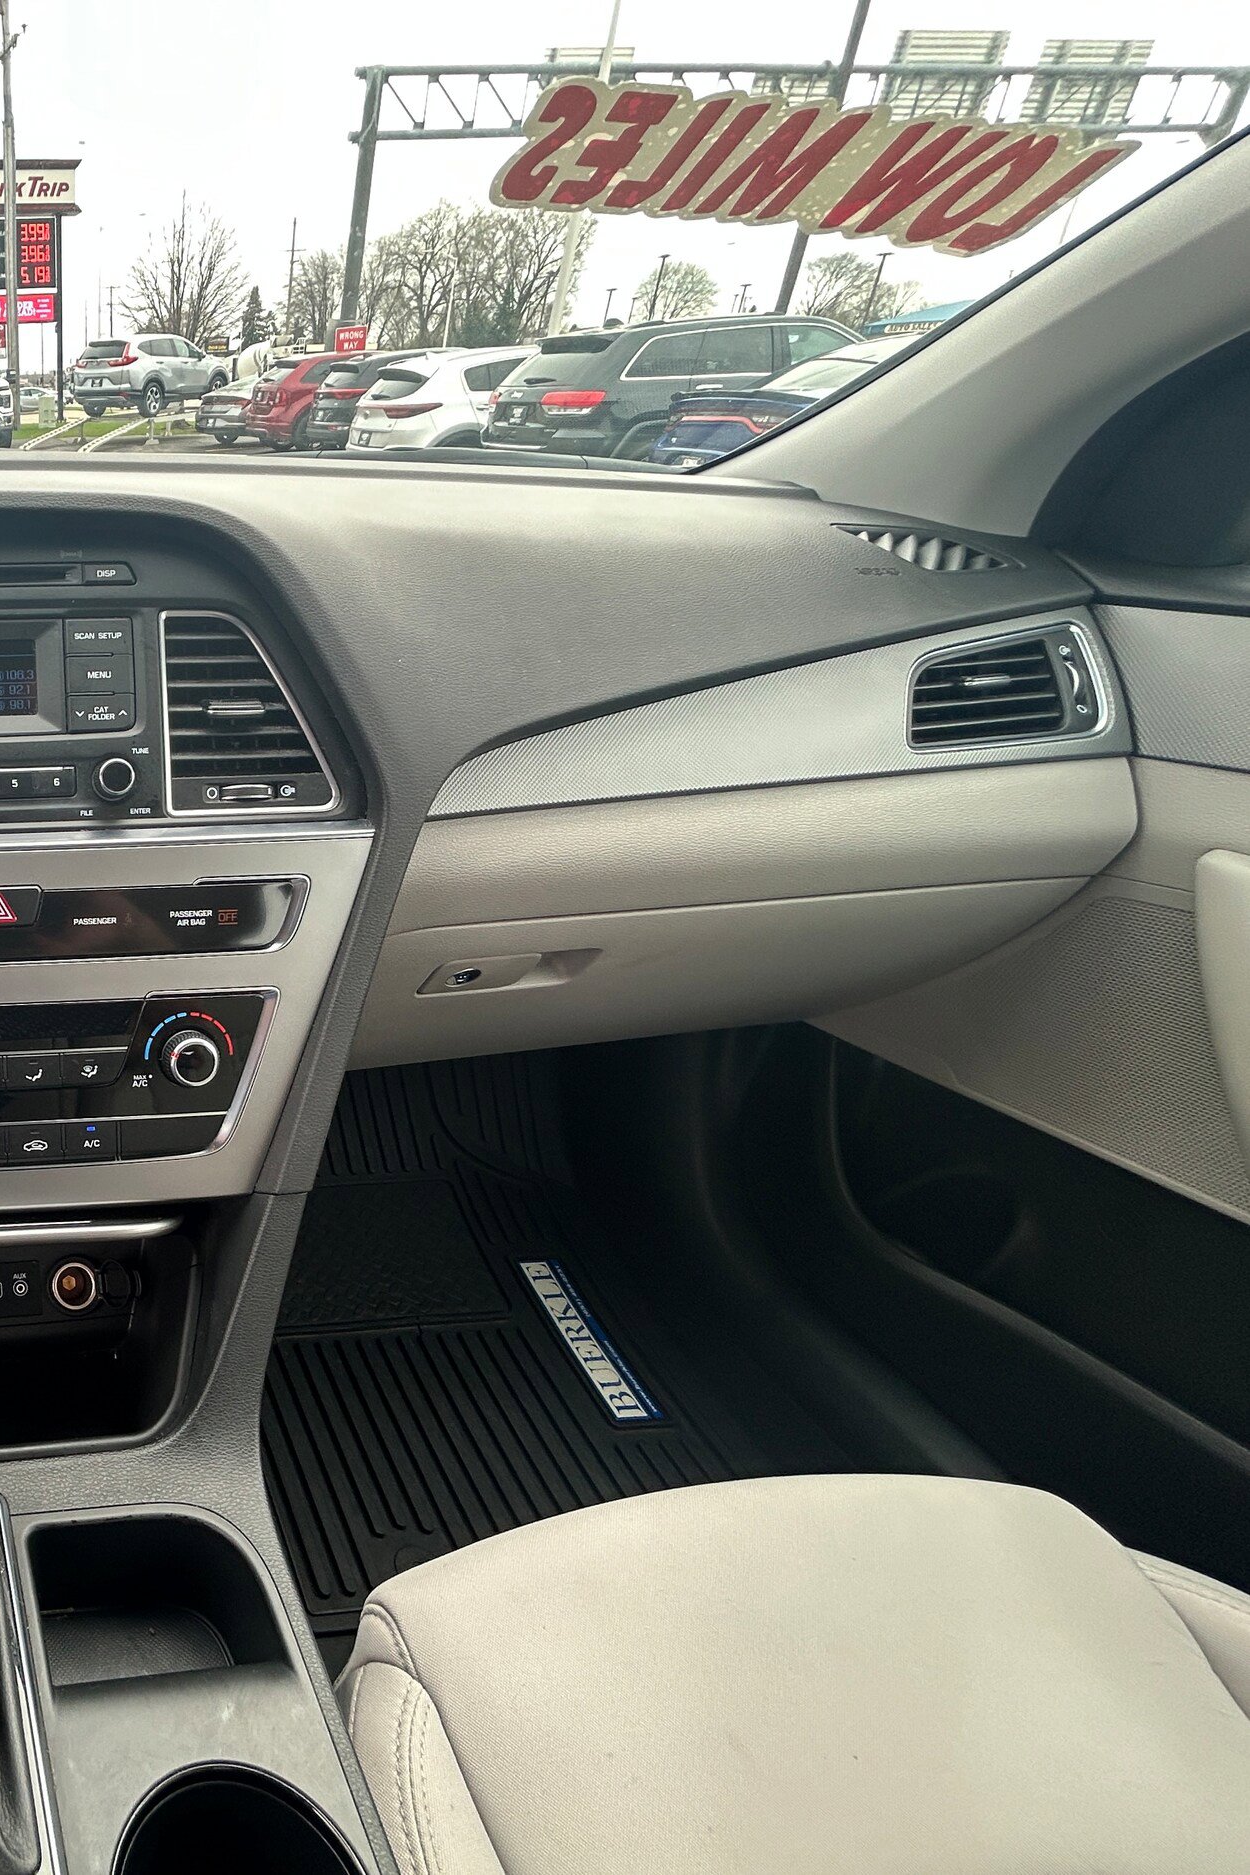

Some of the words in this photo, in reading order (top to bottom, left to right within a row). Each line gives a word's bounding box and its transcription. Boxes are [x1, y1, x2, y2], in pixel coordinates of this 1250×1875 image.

[340, 331, 364, 339] WRONG
[344, 342, 358, 350] WAY
[95, 570, 116, 578] DISP
[98, 632, 122, 640] SETUP
[87, 671, 111, 679] MENU
[88, 713, 115, 721] FOLDER
[11, 780, 18, 788] 5
[53, 778, 60, 786] 6
[169, 909, 212, 918] PASSENGER
[218, 911, 237, 922] OFF
[73, 917, 117, 926] PASSENGER
[83, 1139, 100, 1148] A/C
[13, 1272, 26, 1280] AUX
[525, 1263, 642, 1411] BUERKLE
